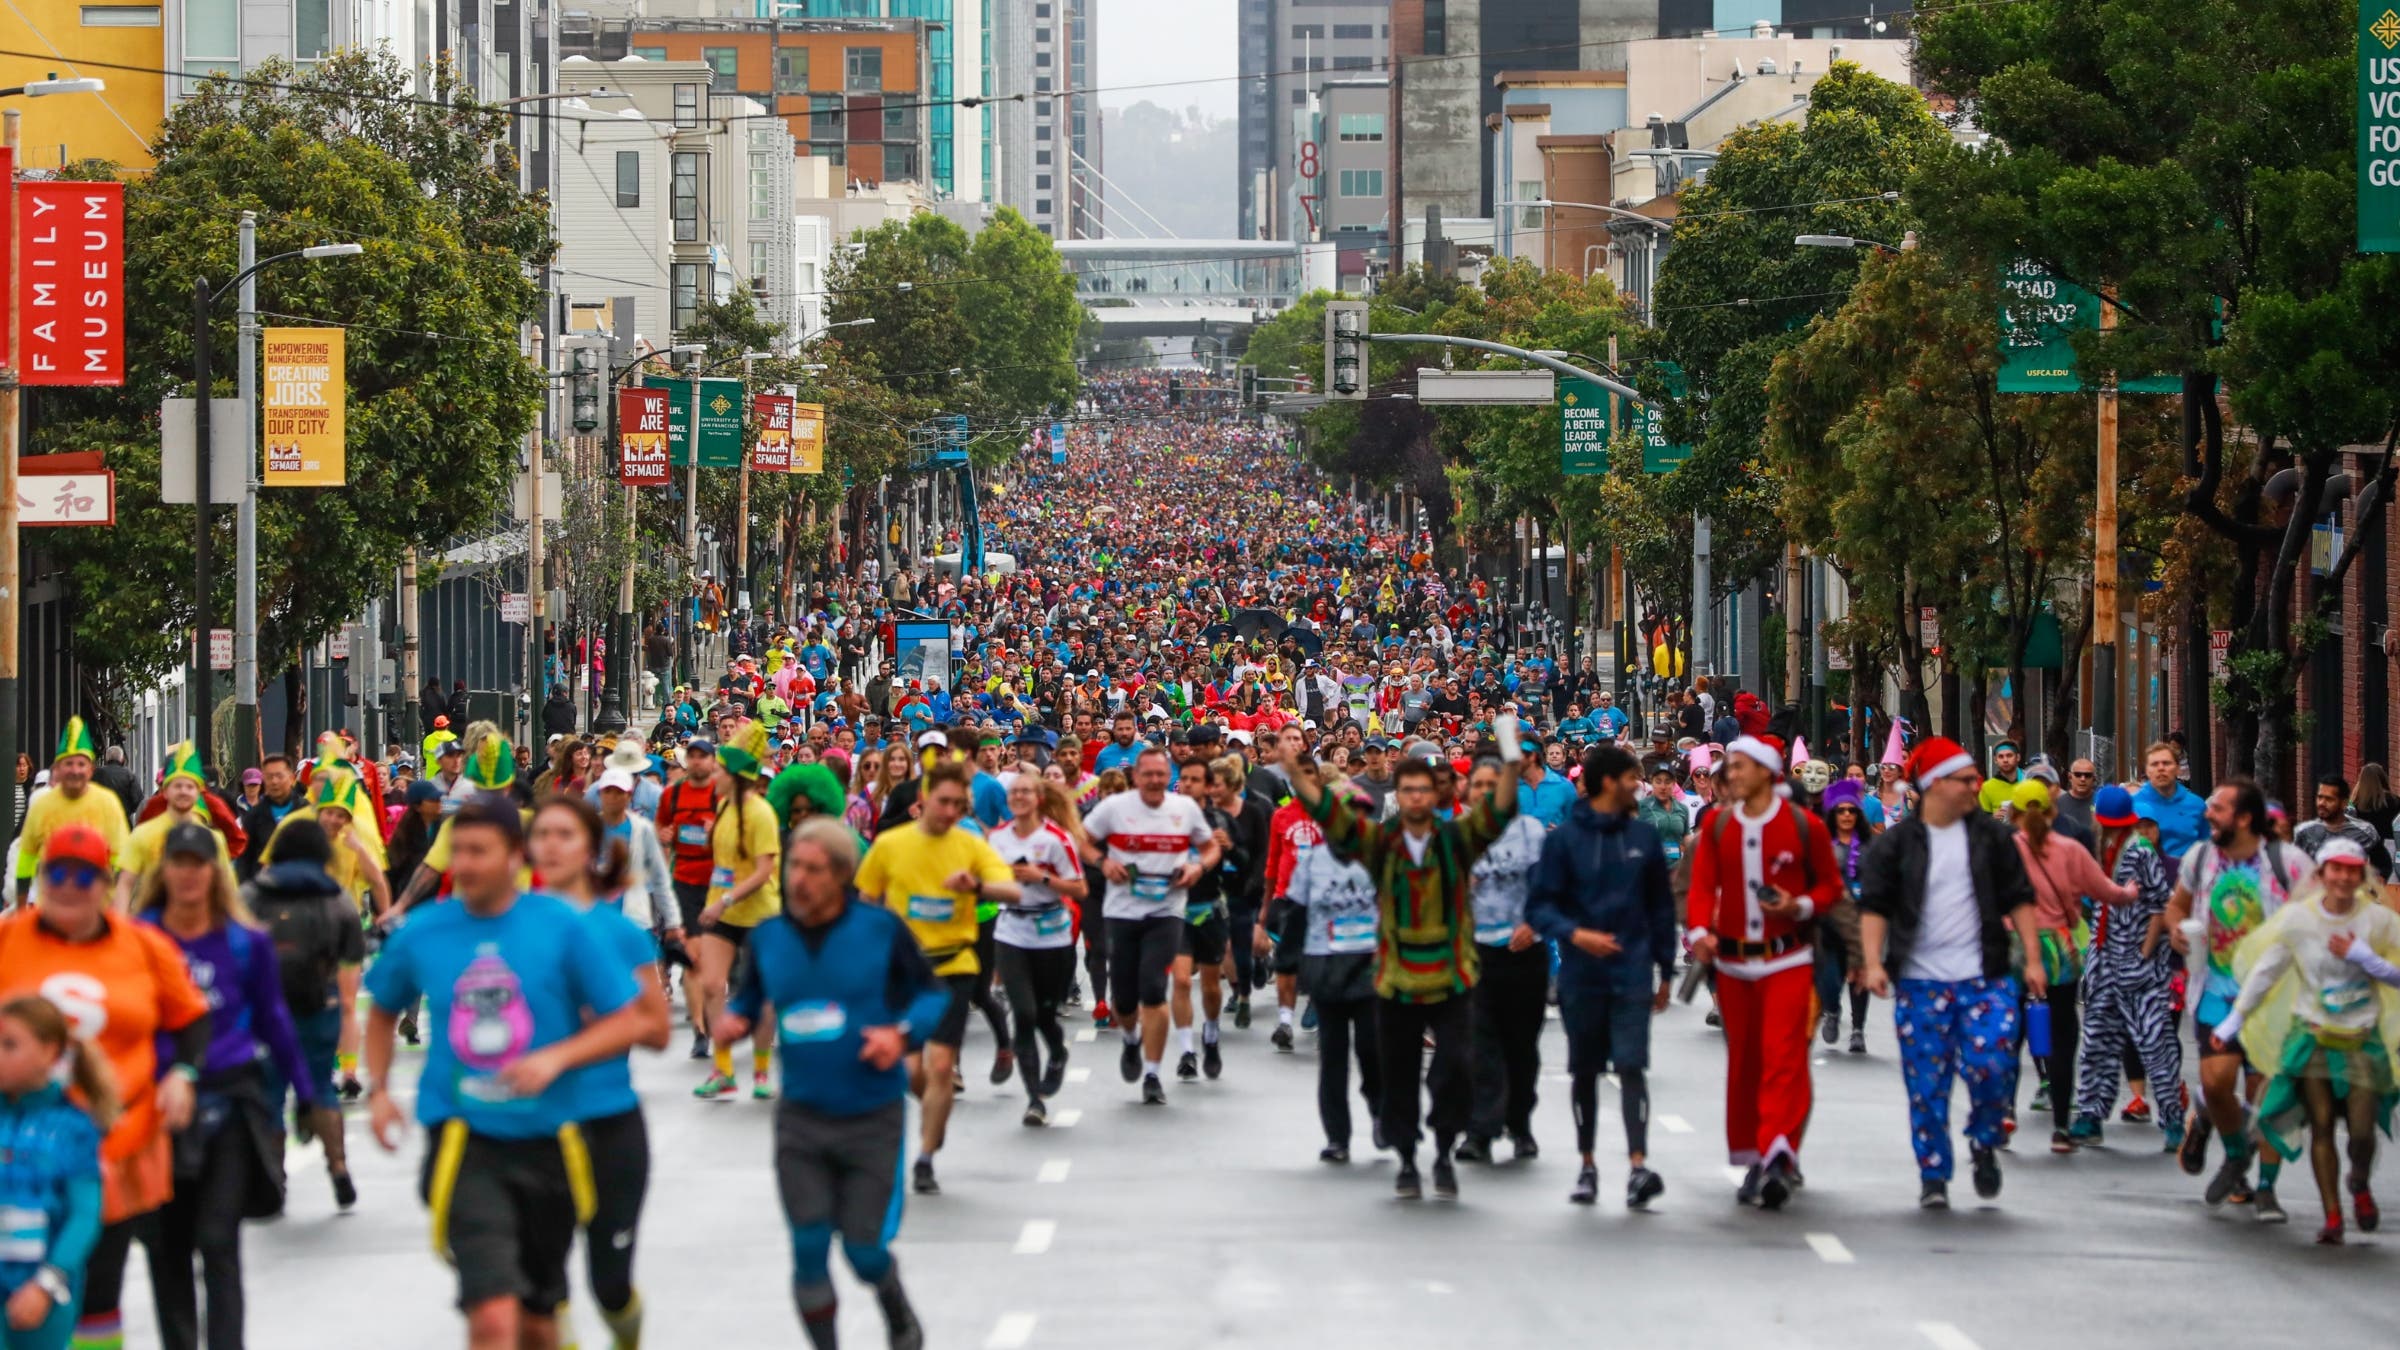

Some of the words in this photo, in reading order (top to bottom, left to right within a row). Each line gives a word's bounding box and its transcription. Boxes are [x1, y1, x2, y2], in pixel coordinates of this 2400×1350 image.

[33, 196, 56, 372] FAMILY
[84, 196, 108, 372] MUSEUM
[268, 343, 329, 355] EMPOWERING
[268, 366, 330, 382] CREATING
[2026, 369, 2069, 377] USFCA.EDU
[268, 382, 327, 406] JOBS.
[644, 397, 665, 413] WE
[773, 402, 790, 417] WE
[268, 408, 330, 419] TRANSFORMING
[1564, 408, 1600, 419] BECOME
[268, 419, 294, 435] OUR
[298, 419, 329, 435] CITY.
[639, 415, 665, 431] ARE
[769, 415, 789, 429] ARE
[1564, 420, 1571, 430] A
[1573, 419, 1605, 430] BETTER
[1564, 430, 1597, 441] LEADER
[1565, 442, 1583, 453] DAY
[270, 460, 300, 471] SFMADE
[755, 453, 788, 466] SFMADE
[624, 464, 665, 477] SFMADE
[1921, 609, 1933, 620] NO
[209, 633, 232, 641] ARKING
[2213, 632, 2227, 648] NO
